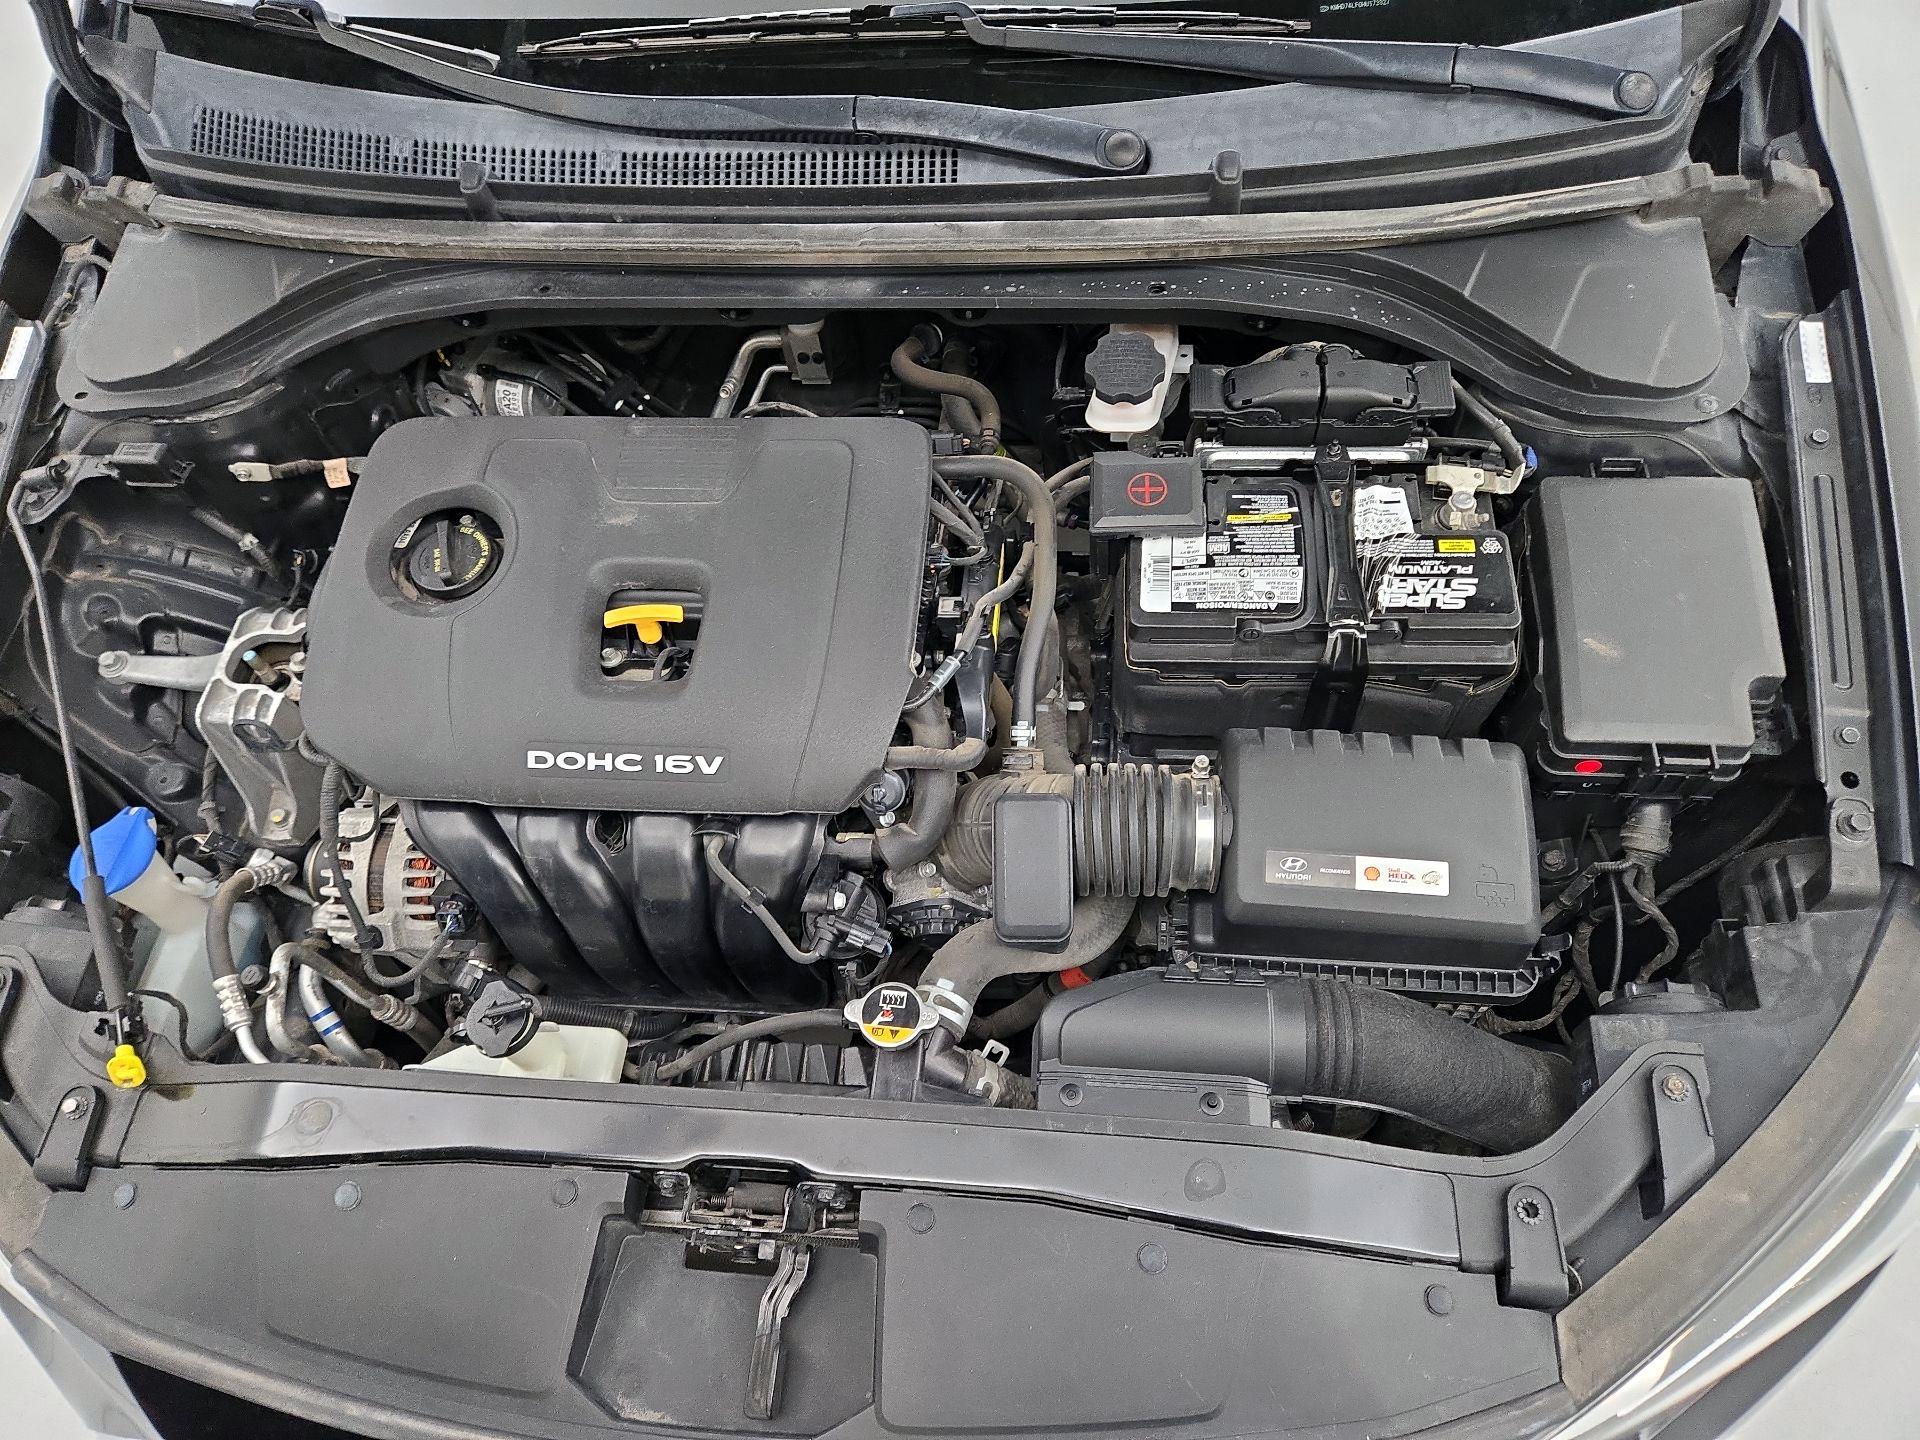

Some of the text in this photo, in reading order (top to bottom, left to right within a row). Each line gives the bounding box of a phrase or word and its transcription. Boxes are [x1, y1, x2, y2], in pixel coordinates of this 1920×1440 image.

[1388, 564, 1473, 575] PLATINUM
[1380, 576, 1479, 596] START
[1378, 589, 1466, 609] SUPER
[527, 750, 724, 775] DOHC 16V
[1275, 872, 1312, 881] HYUNDAI
[1388, 872, 1416, 880] HELIX
